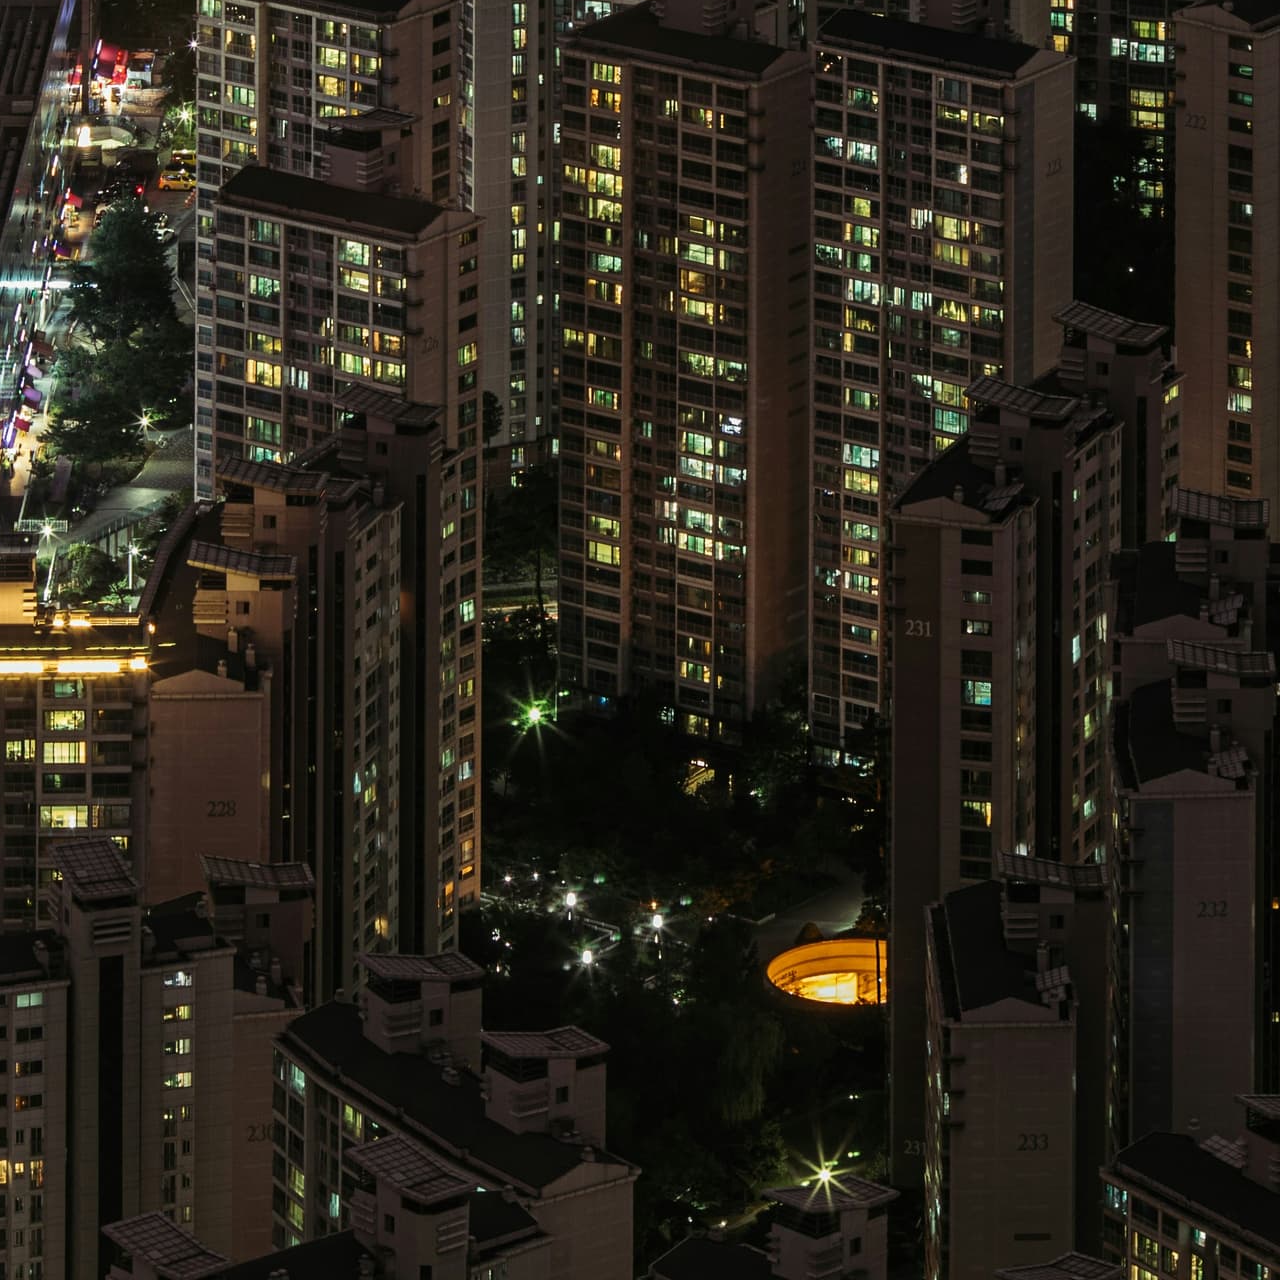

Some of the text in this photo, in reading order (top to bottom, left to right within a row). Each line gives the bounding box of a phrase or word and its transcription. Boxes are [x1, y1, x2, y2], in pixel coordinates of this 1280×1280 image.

[1183, 113, 1207, 130] 222
[905, 619, 933, 638] 231
[207, 800, 237, 818] 228
[1197, 900, 1228, 919] 232
[1016, 1133, 1049, 1151] 233
